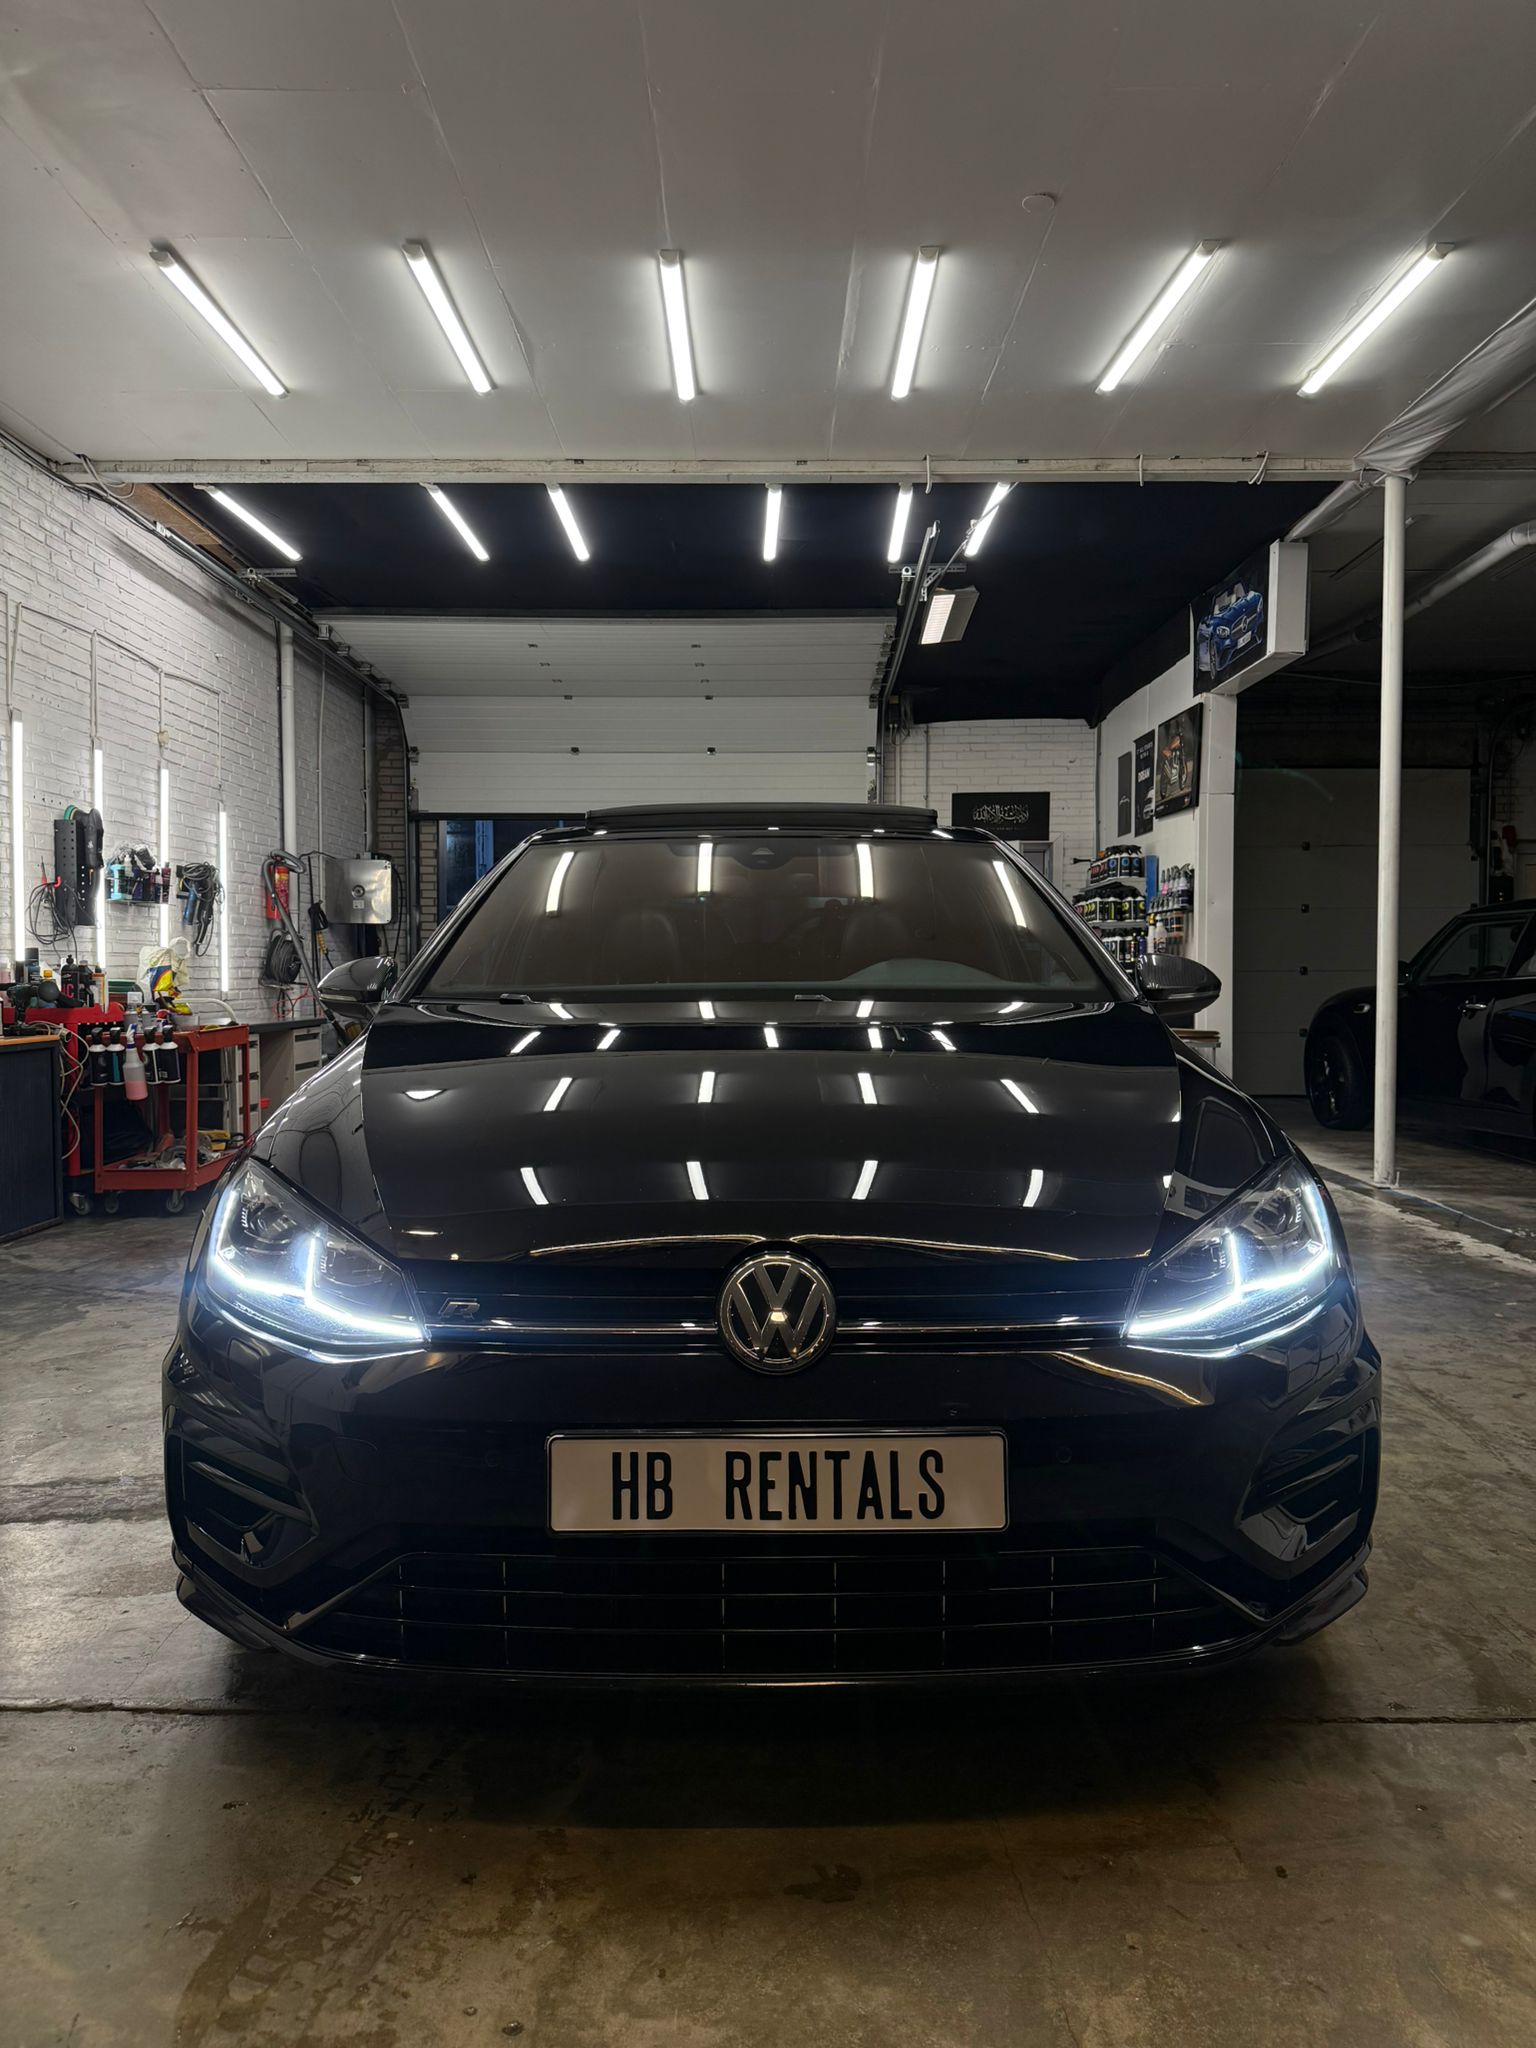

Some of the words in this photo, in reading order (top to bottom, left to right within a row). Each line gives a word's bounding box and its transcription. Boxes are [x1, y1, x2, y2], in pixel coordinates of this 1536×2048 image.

[439, 1297, 480, 1319] R
[730, 1261, 826, 1363] VW
[612, 1451, 673, 1521] HB
[725, 1449, 945, 1521] RENTALS
